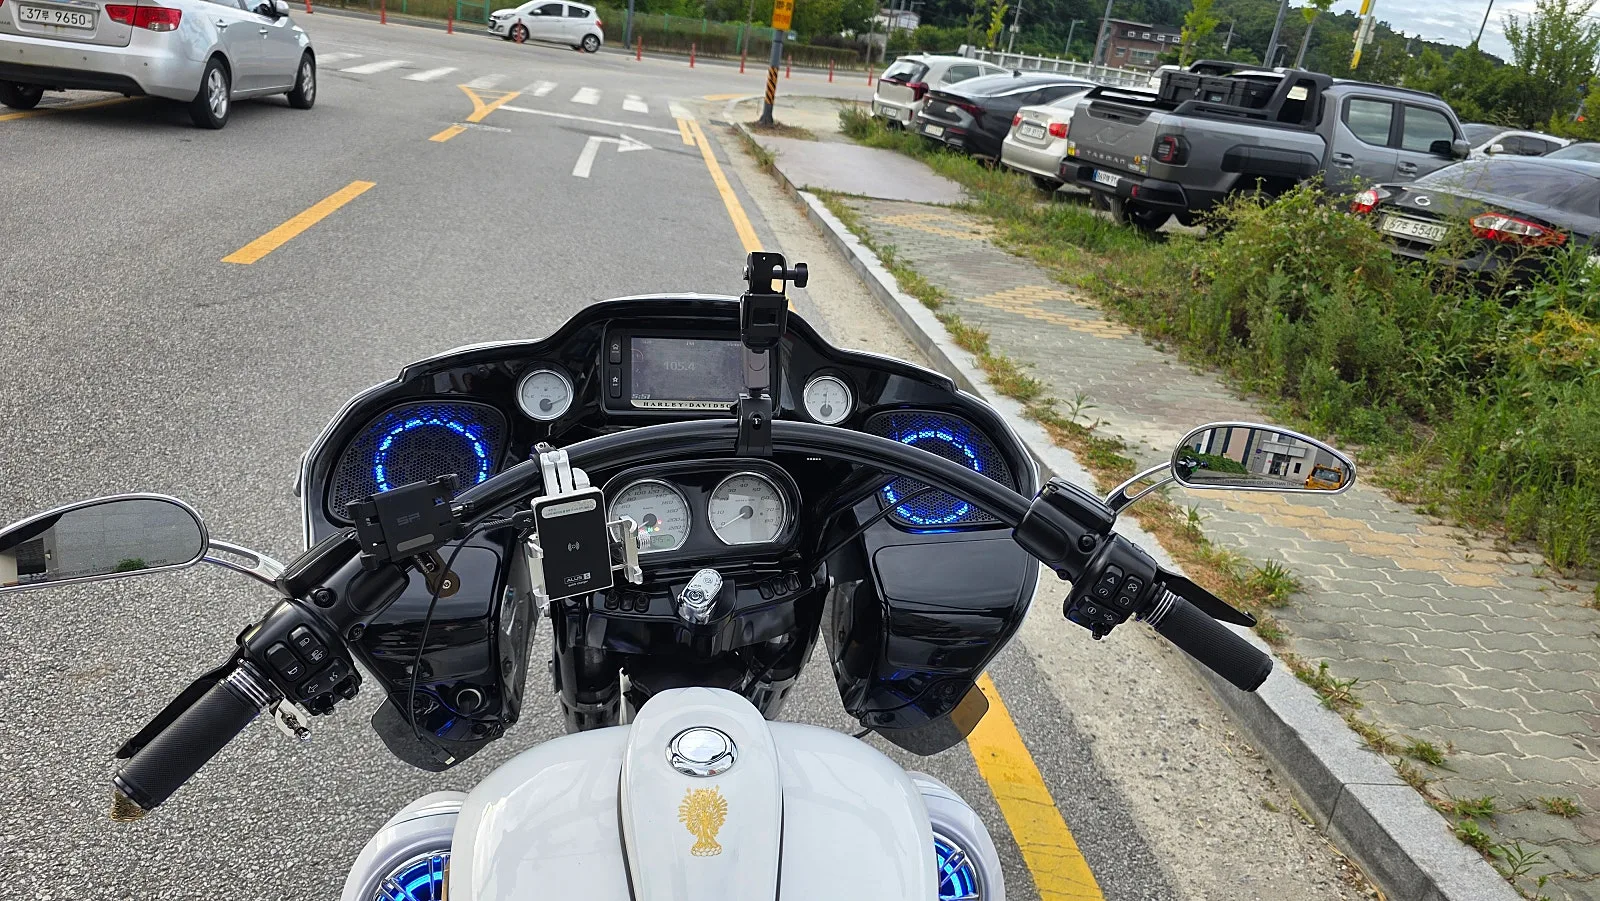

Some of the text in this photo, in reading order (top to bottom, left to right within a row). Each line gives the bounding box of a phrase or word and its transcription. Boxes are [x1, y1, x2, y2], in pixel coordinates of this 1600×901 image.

[26, 8, 86, 26] 37루 9650
[1085, 150, 1125, 165] TASMAN
[1411, 223, 1440, 239] 5540
[663, 360, 695, 371] 105.4
[643, 401, 732, 409] HARLEY-DAVIDSO
